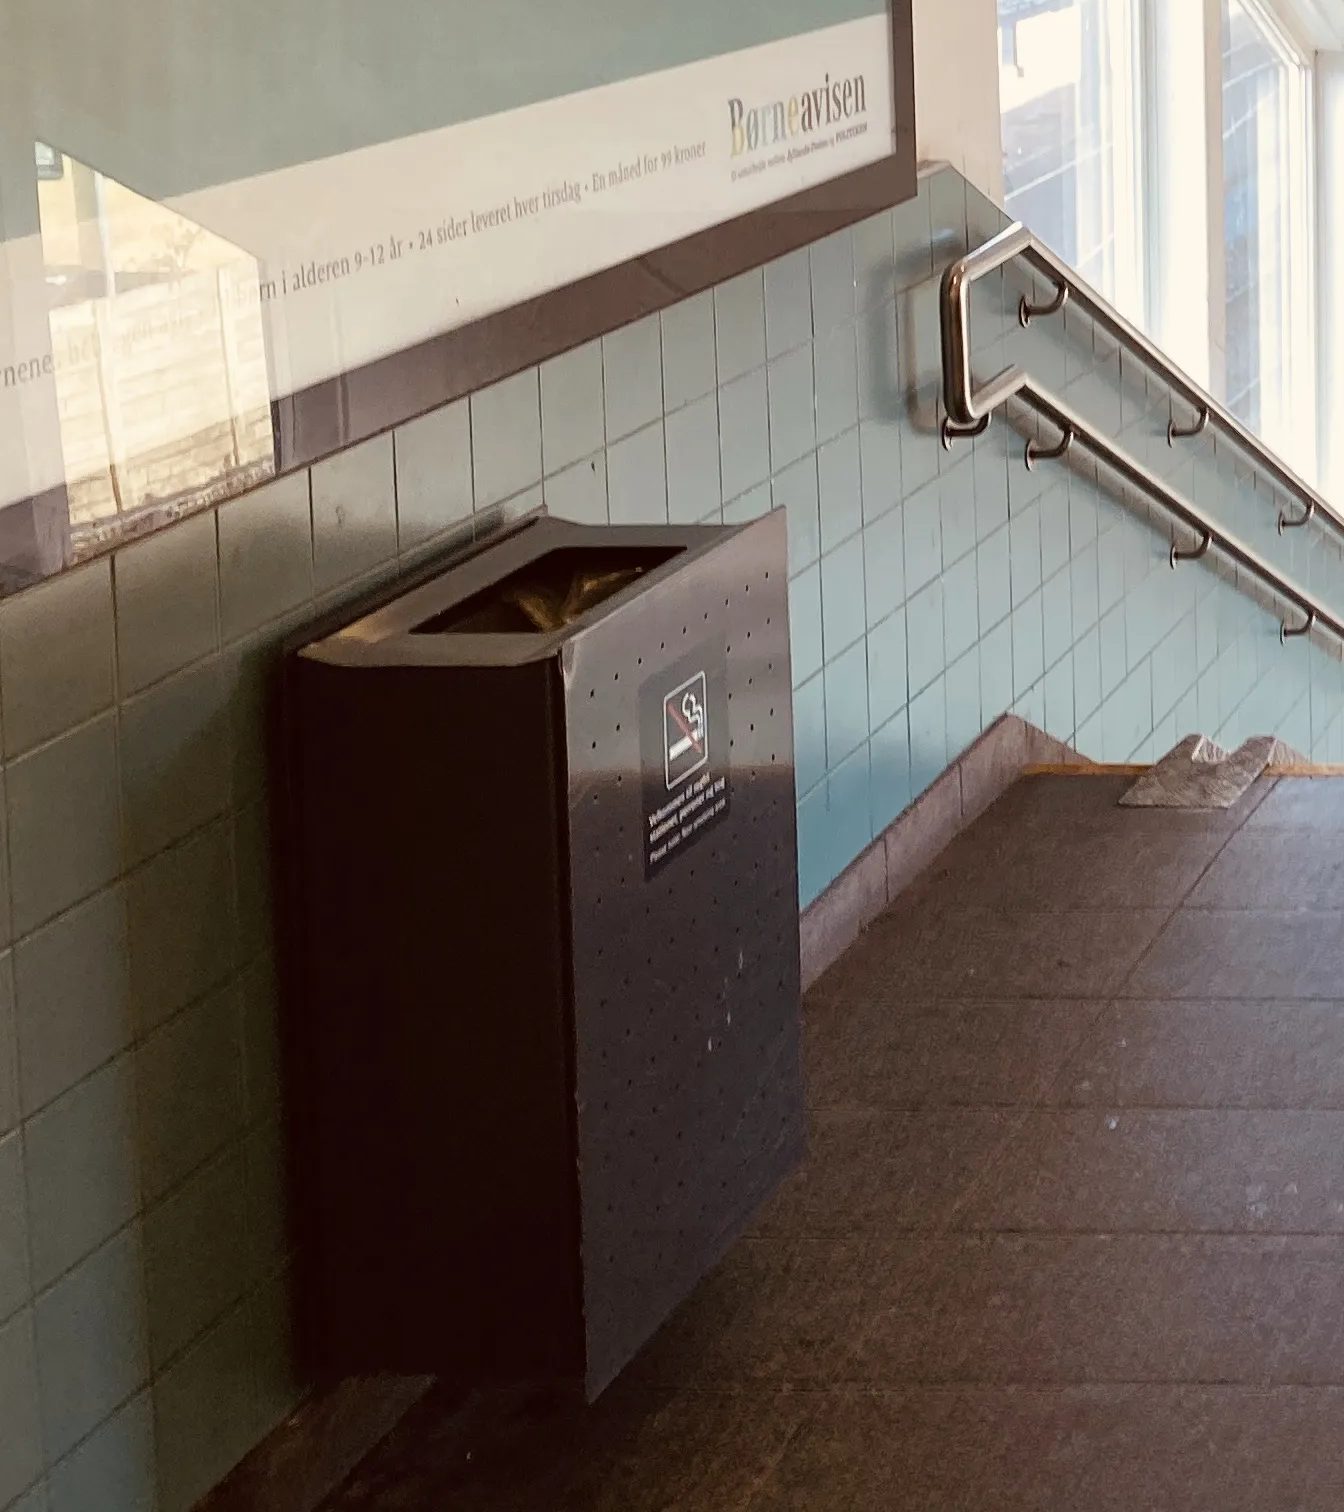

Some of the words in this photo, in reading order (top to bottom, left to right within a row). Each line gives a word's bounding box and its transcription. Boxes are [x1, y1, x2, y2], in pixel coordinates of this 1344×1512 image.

[728, 72, 867, 160] Børneavisen
[282, 269, 287, 296] i
[292, 261, 351, 292] alderen
[354, 243, 385, 272] 9-12
[389, 234, 403, 260] år
[418, 228, 433, 251] 24
[436, 218, 467, 245] sider
[470, 203, 511, 235] leveret
[514, 195, 540, 220] hver
[542, 180, 582, 210] tirsdag
[592, 171, 607, 194] En
[608, 156, 642, 189] måned
[643, 154, 659, 175] for
[661, 151, 673, 171] 99
[674, 140, 707, 167] kroner
